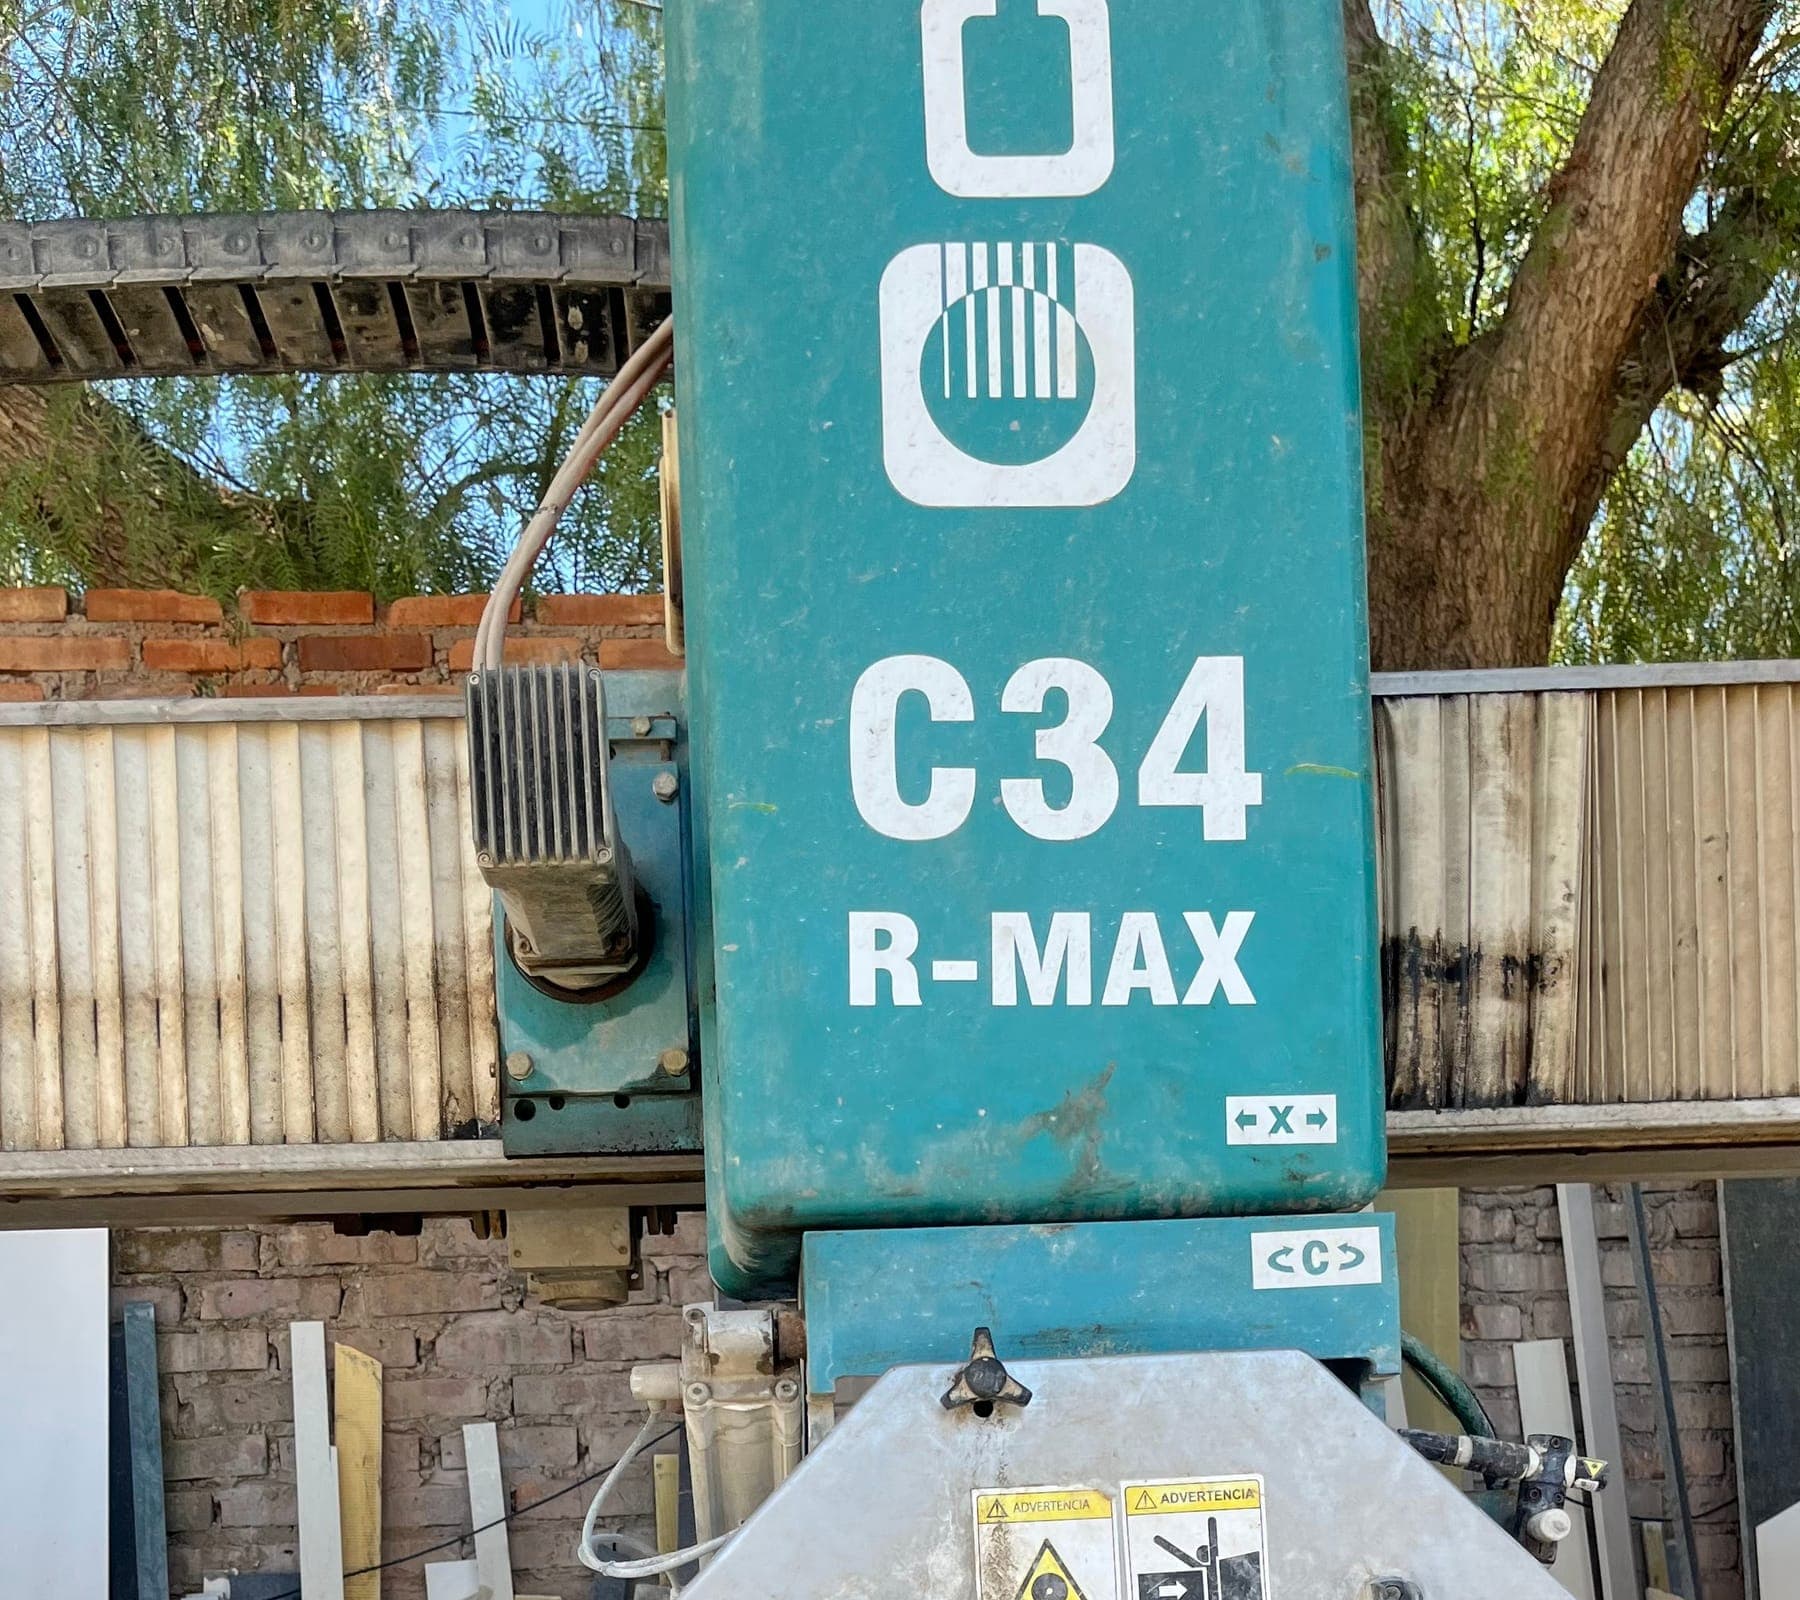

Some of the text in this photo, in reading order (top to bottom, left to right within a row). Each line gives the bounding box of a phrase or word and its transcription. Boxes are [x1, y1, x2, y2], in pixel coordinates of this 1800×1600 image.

[849, 654, 1263, 841] C34
[848, 910, 1257, 1007] R-MAX
[1268, 1105, 1294, 1135] X
[1302, 1240, 1329, 1276] C
[1013, 1499, 1090, 1513] ADVERTENCIA
[1159, 1487, 1255, 1505] ADVERTENCIA
